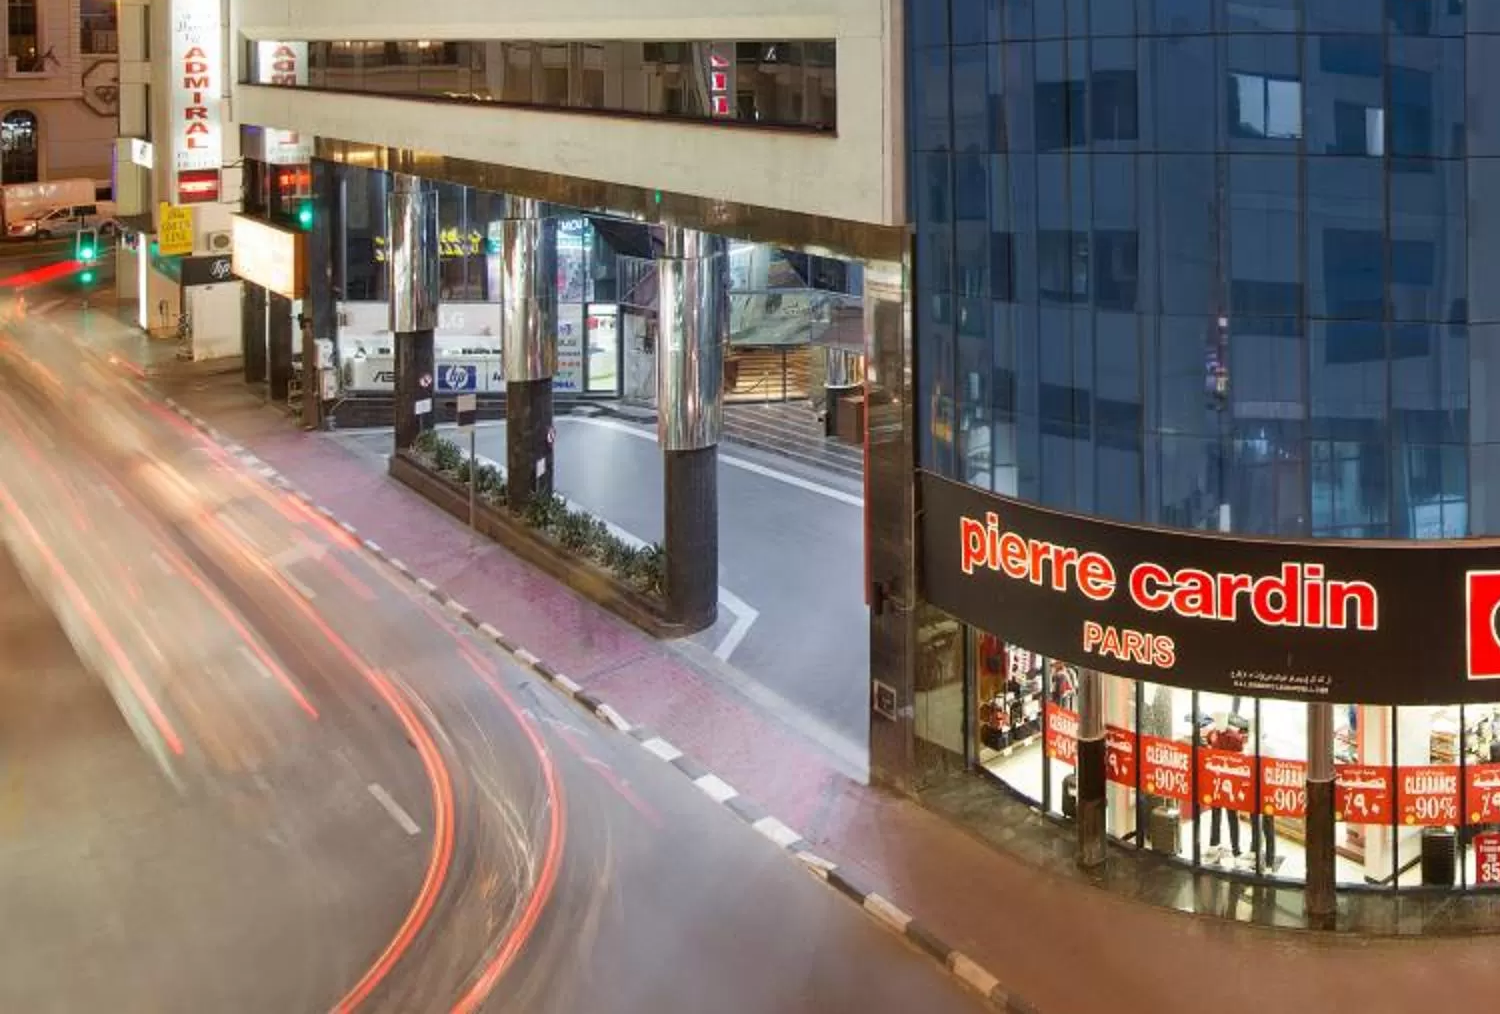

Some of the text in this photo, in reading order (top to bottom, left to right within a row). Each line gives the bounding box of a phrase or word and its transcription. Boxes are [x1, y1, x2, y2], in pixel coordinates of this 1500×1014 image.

[183, 46, 210, 149] ADMIRAL
[960, 511, 1379, 632] pierre cardin
[1083, 621, 1176, 670] PARIS
[1145, 744, 1189, 770] CLEARANCE
[1155, 768, 1189, 795] 90%
[1405, 776, 1457, 795] CLEARANCE
[1415, 795, 1457, 820] 90%
